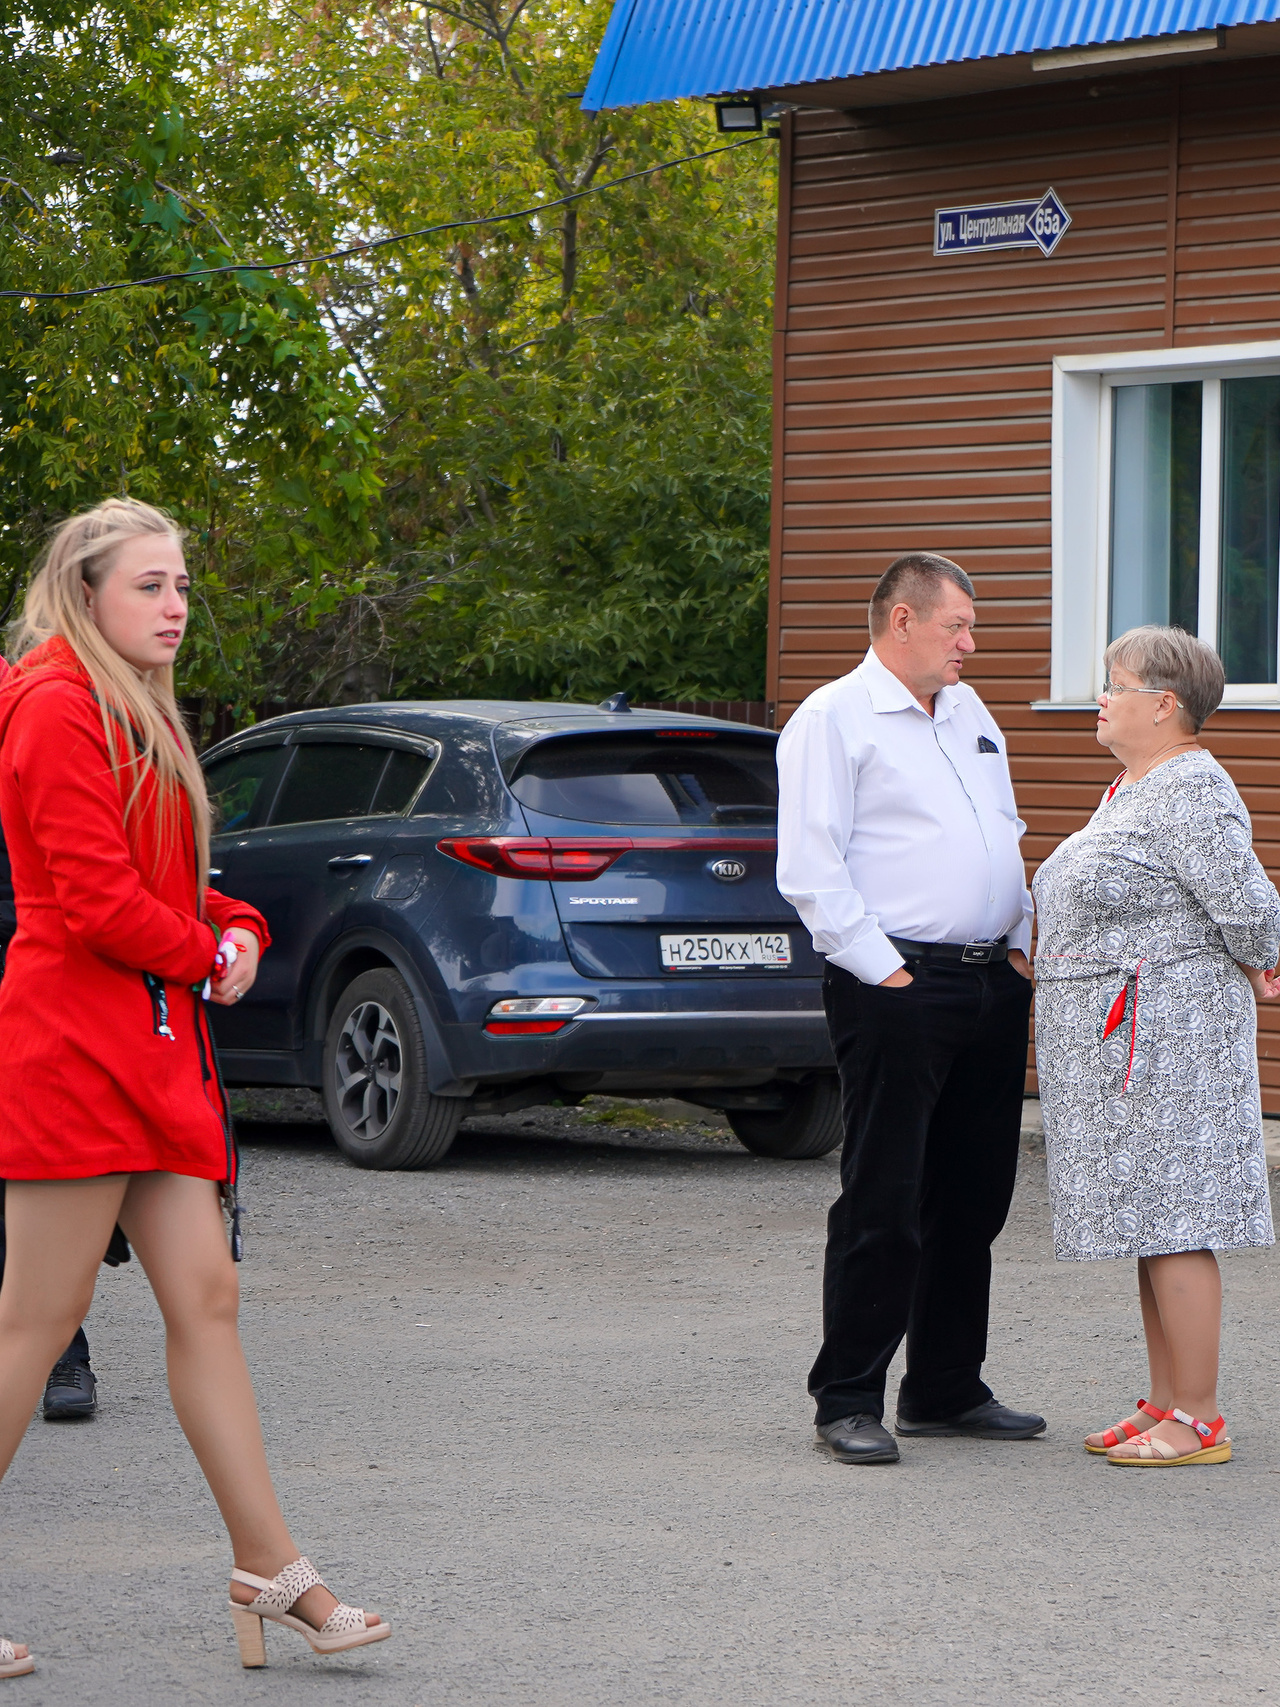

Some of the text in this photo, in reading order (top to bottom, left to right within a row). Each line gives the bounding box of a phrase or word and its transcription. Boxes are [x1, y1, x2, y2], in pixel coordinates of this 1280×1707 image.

[940, 214, 1026, 248] ул. Центральная
[1035, 208, 1060, 236] 65а
[718, 863, 741, 876] KIA
[569, 897, 639, 905] SPORTAGE
[754, 936, 784, 954] 142
